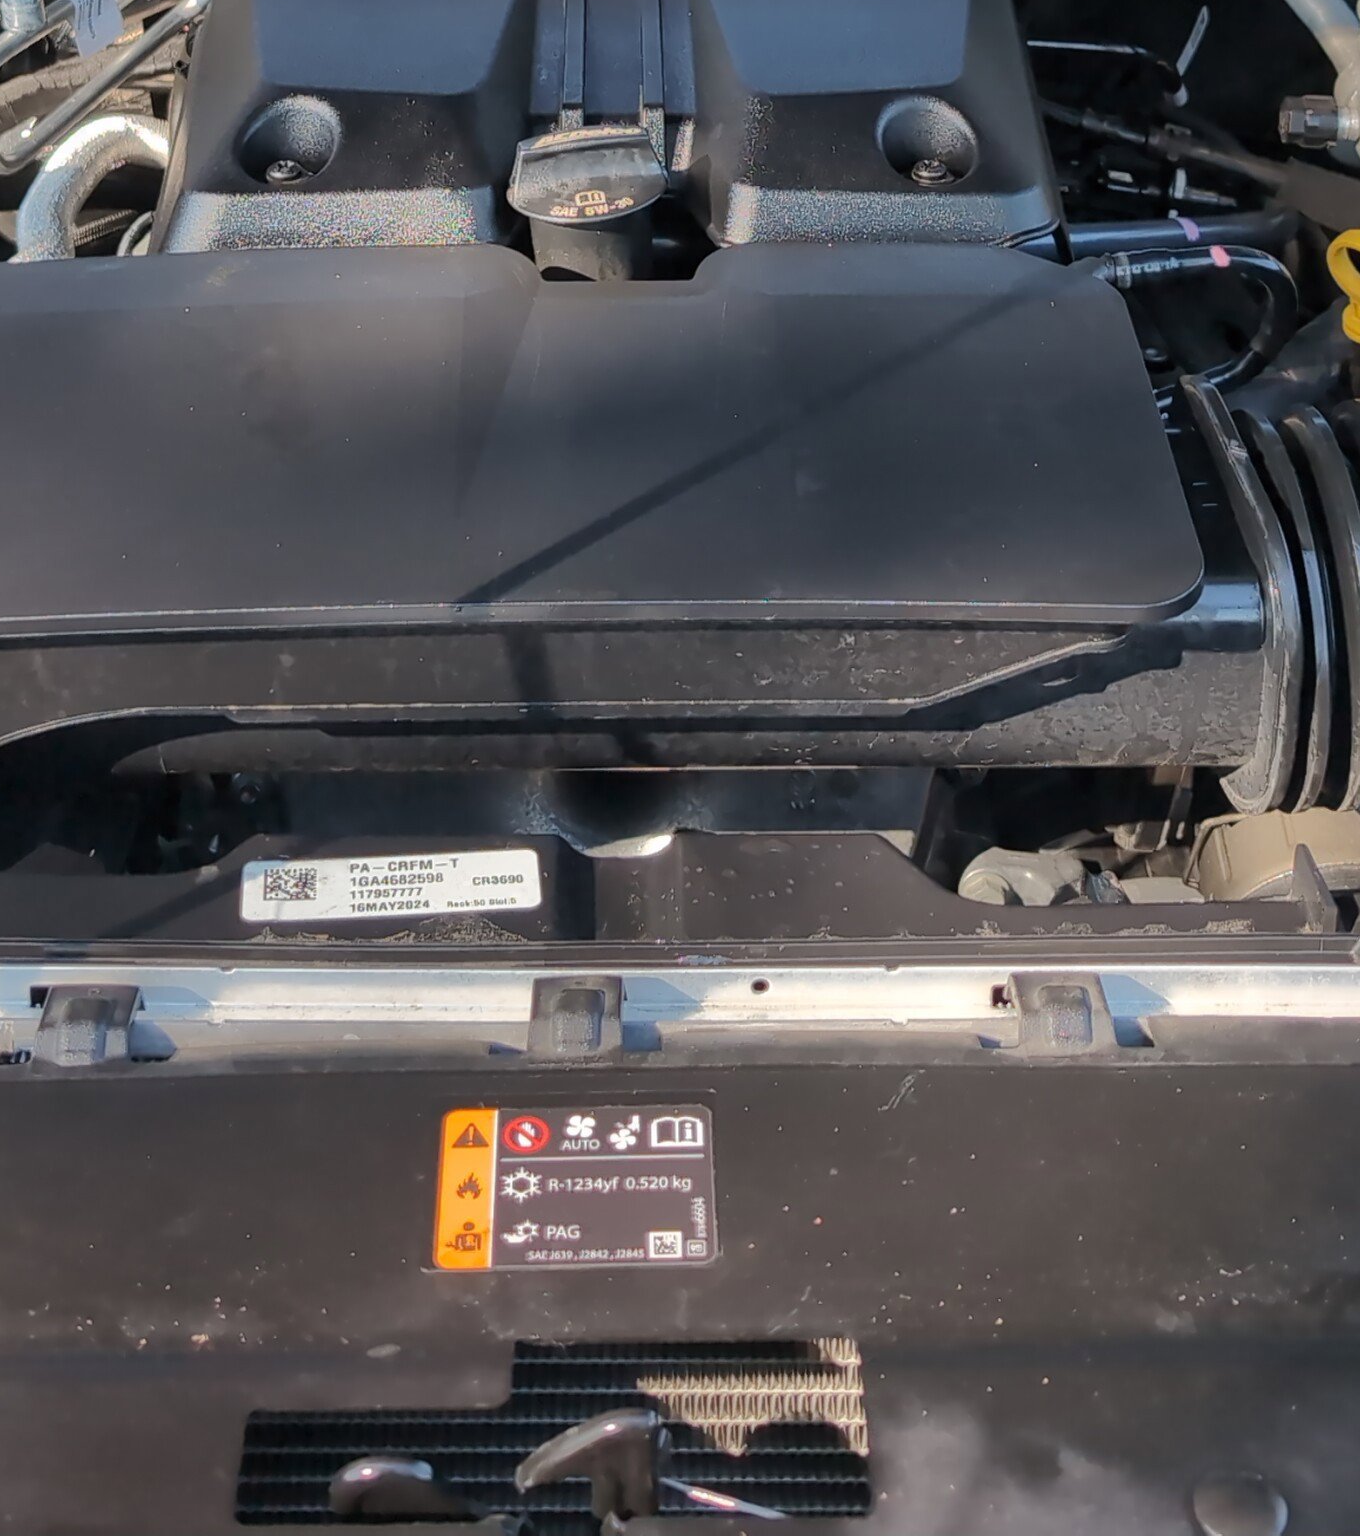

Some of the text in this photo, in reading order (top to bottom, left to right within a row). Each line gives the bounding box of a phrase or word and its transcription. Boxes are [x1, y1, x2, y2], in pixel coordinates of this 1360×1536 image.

[550, 206, 578, 217] SAE
[350, 872, 444, 887] 1GA4682598
[472, 874, 524, 886] CR3690
[350, 887, 423, 900] 117957777
[350, 900, 430, 913] 16MAY2024
[562, 1139, 600, 1151] AUTO
[548, 1175, 692, 1192] R-1234yf 0.520 kg
[545, 1225, 581, 1240] PAG
[527, 1250, 548, 1261] SAE
